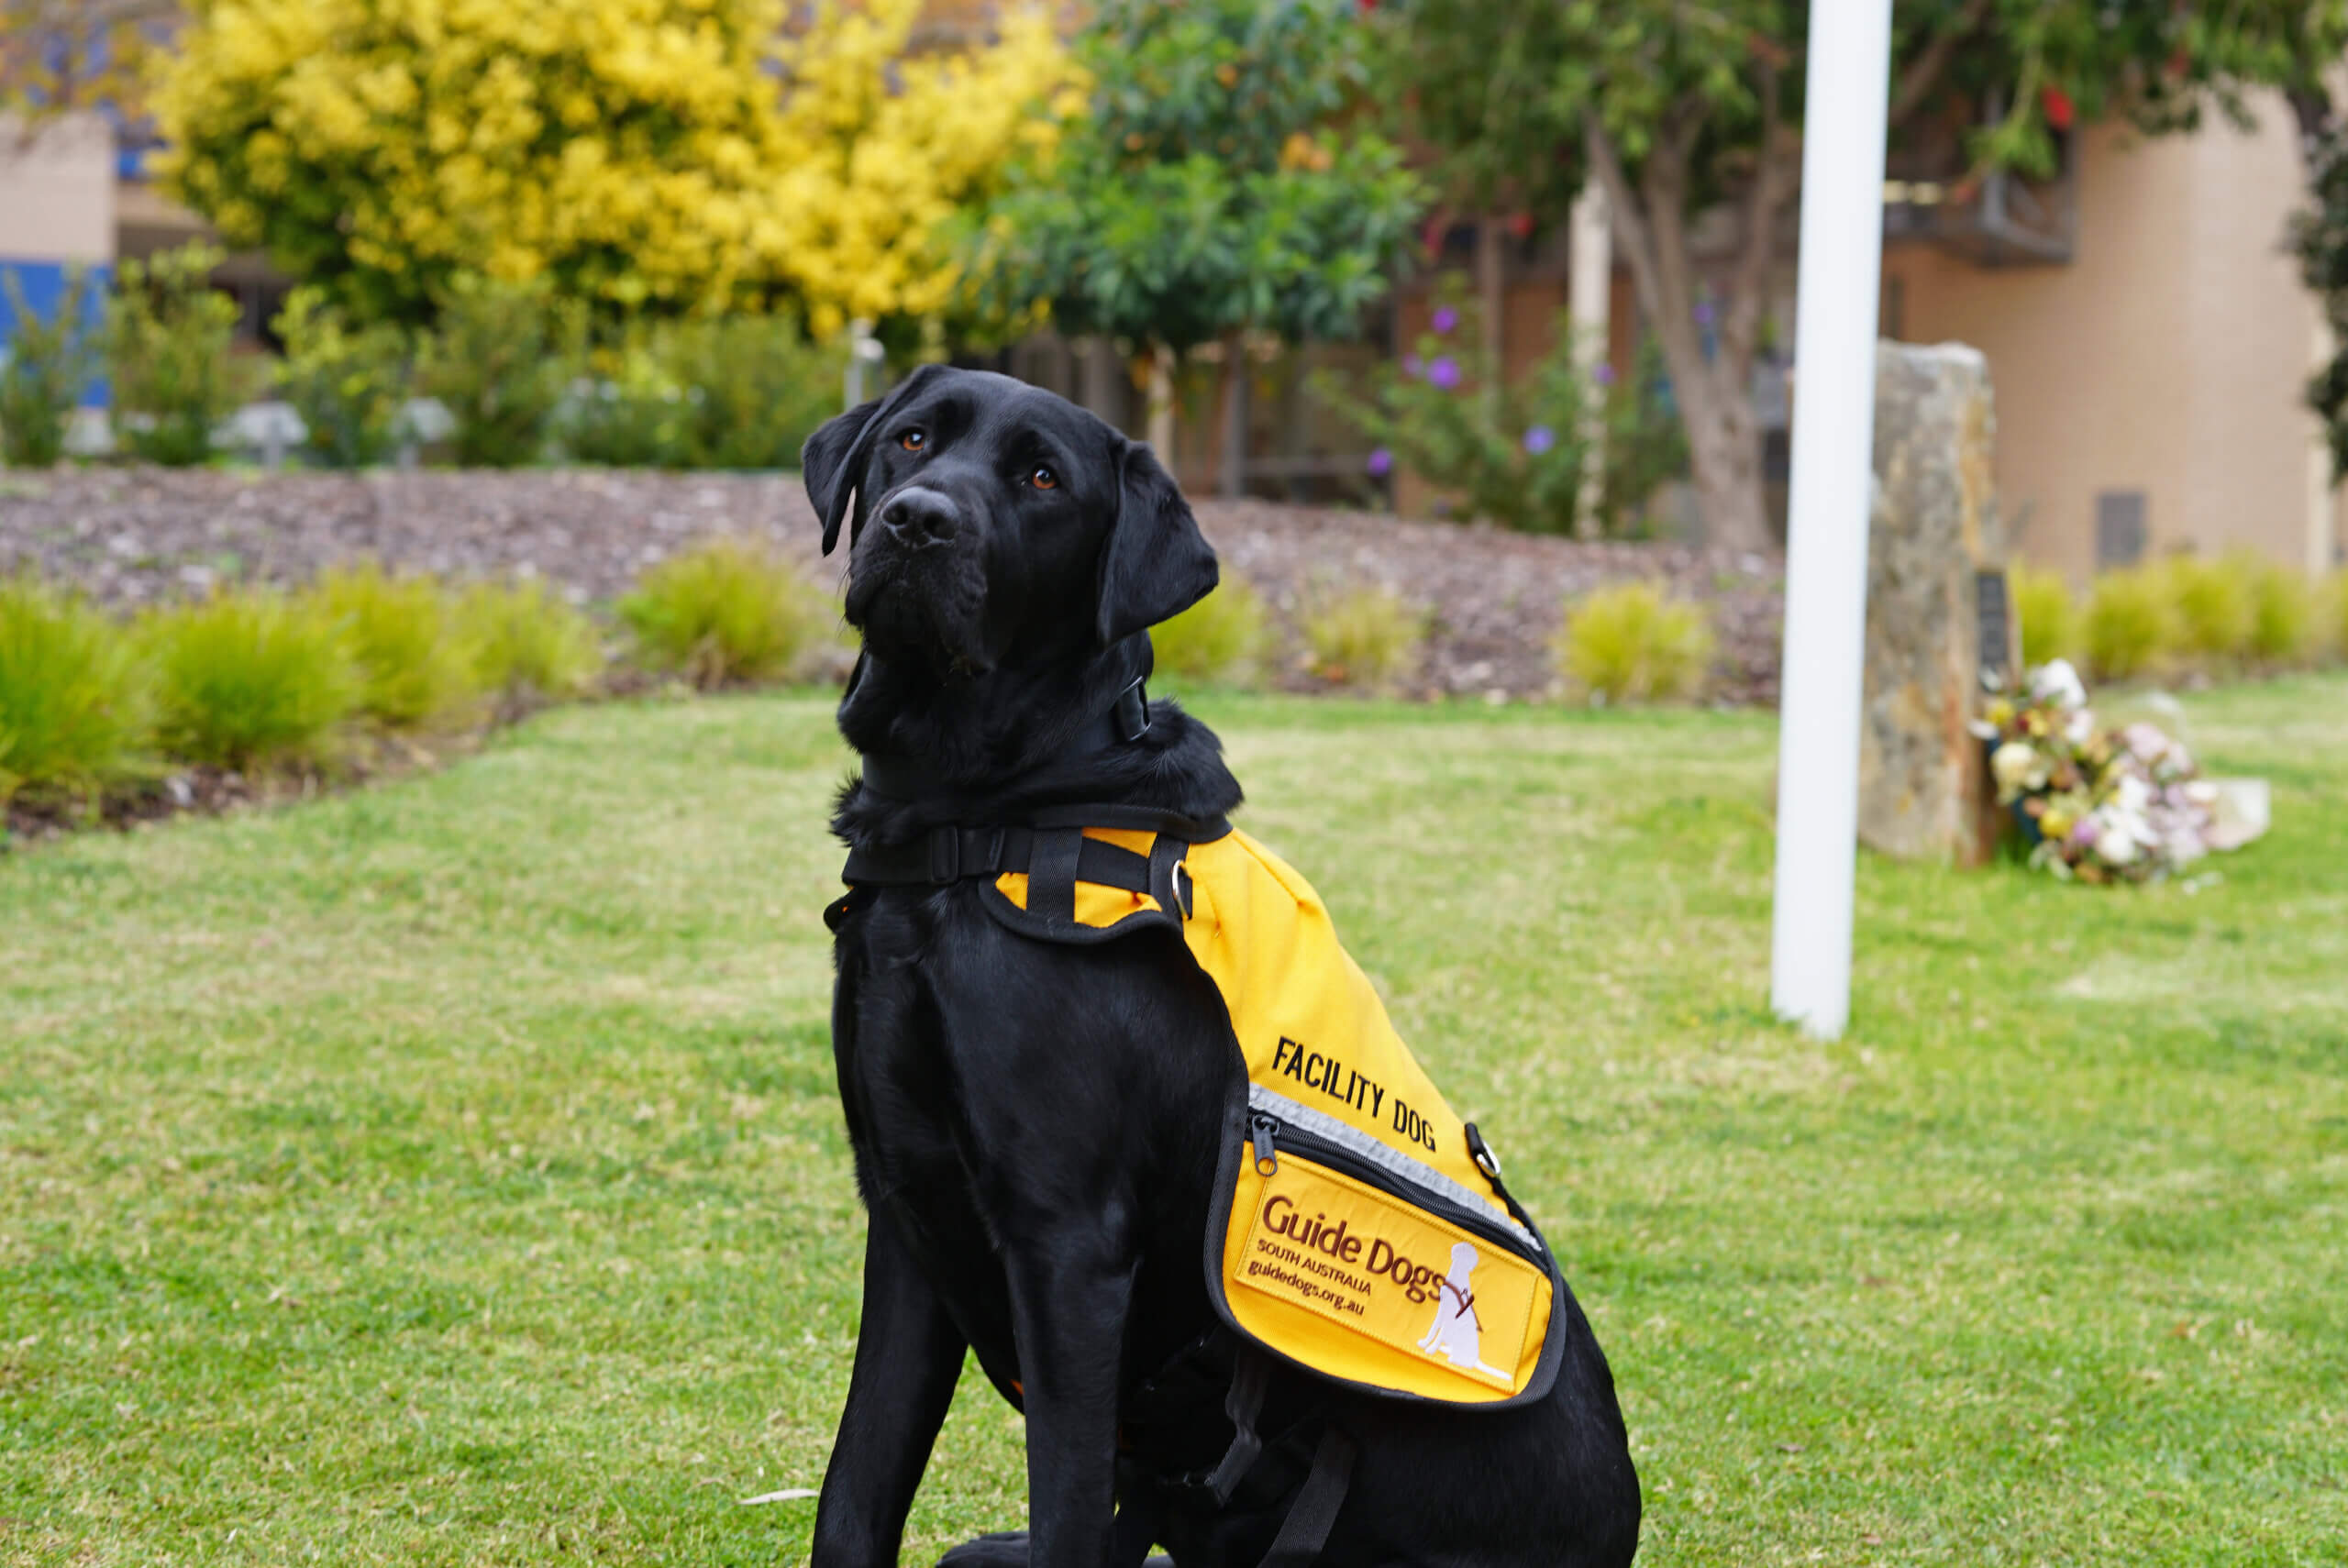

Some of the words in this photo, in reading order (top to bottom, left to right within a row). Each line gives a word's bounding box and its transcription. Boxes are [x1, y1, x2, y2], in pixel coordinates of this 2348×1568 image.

[1272, 1036, 1384, 1118] FACILITY
[1392, 1099, 1436, 1152] DOG
[1247, 1260, 1365, 1316] guidedogs.org.au
[1257, 1240, 1301, 1269] SOUTH
[1301, 1258, 1372, 1297] AUSTRALIA
[1263, 1195, 1362, 1263] Guide
[1365, 1239, 1446, 1304] Dogs
